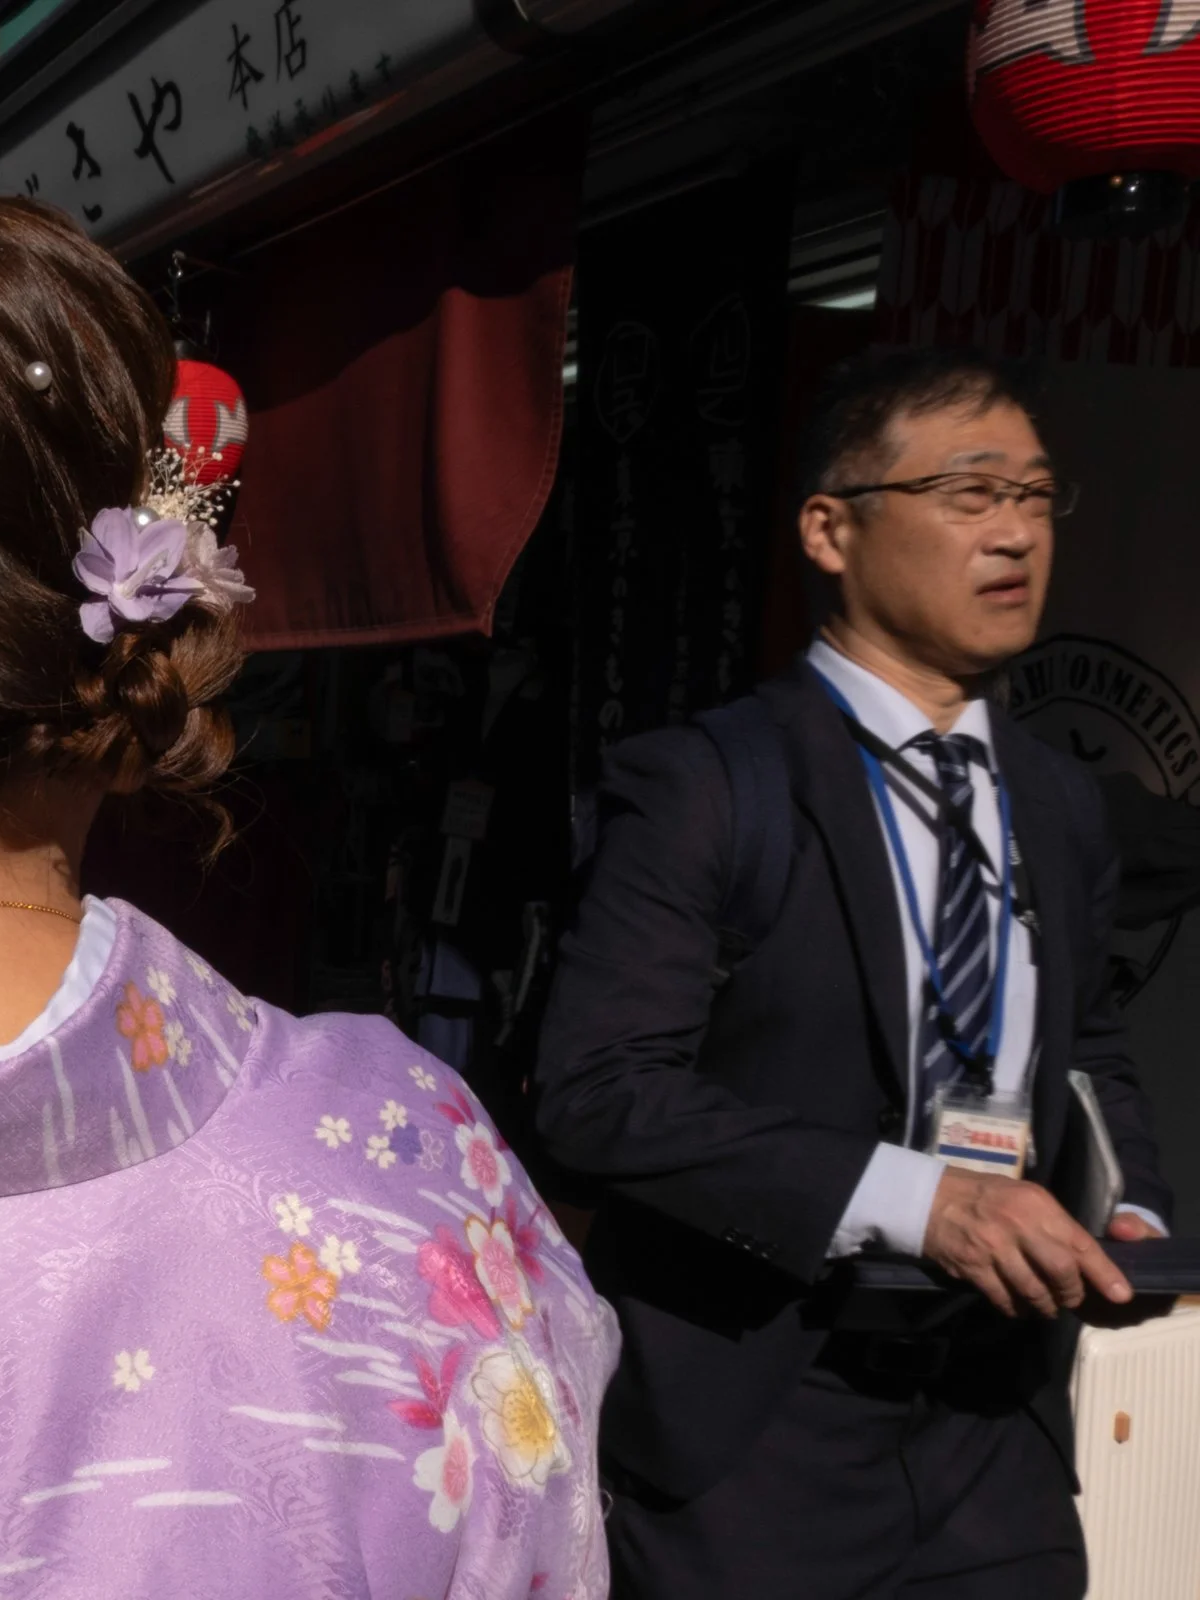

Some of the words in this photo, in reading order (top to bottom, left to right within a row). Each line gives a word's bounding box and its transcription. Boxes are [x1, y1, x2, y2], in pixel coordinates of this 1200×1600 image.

[18, 76, 182, 223] さや
[227, 0, 307, 112] 本店
[1061, 652, 1199, 777] OSMETICS
